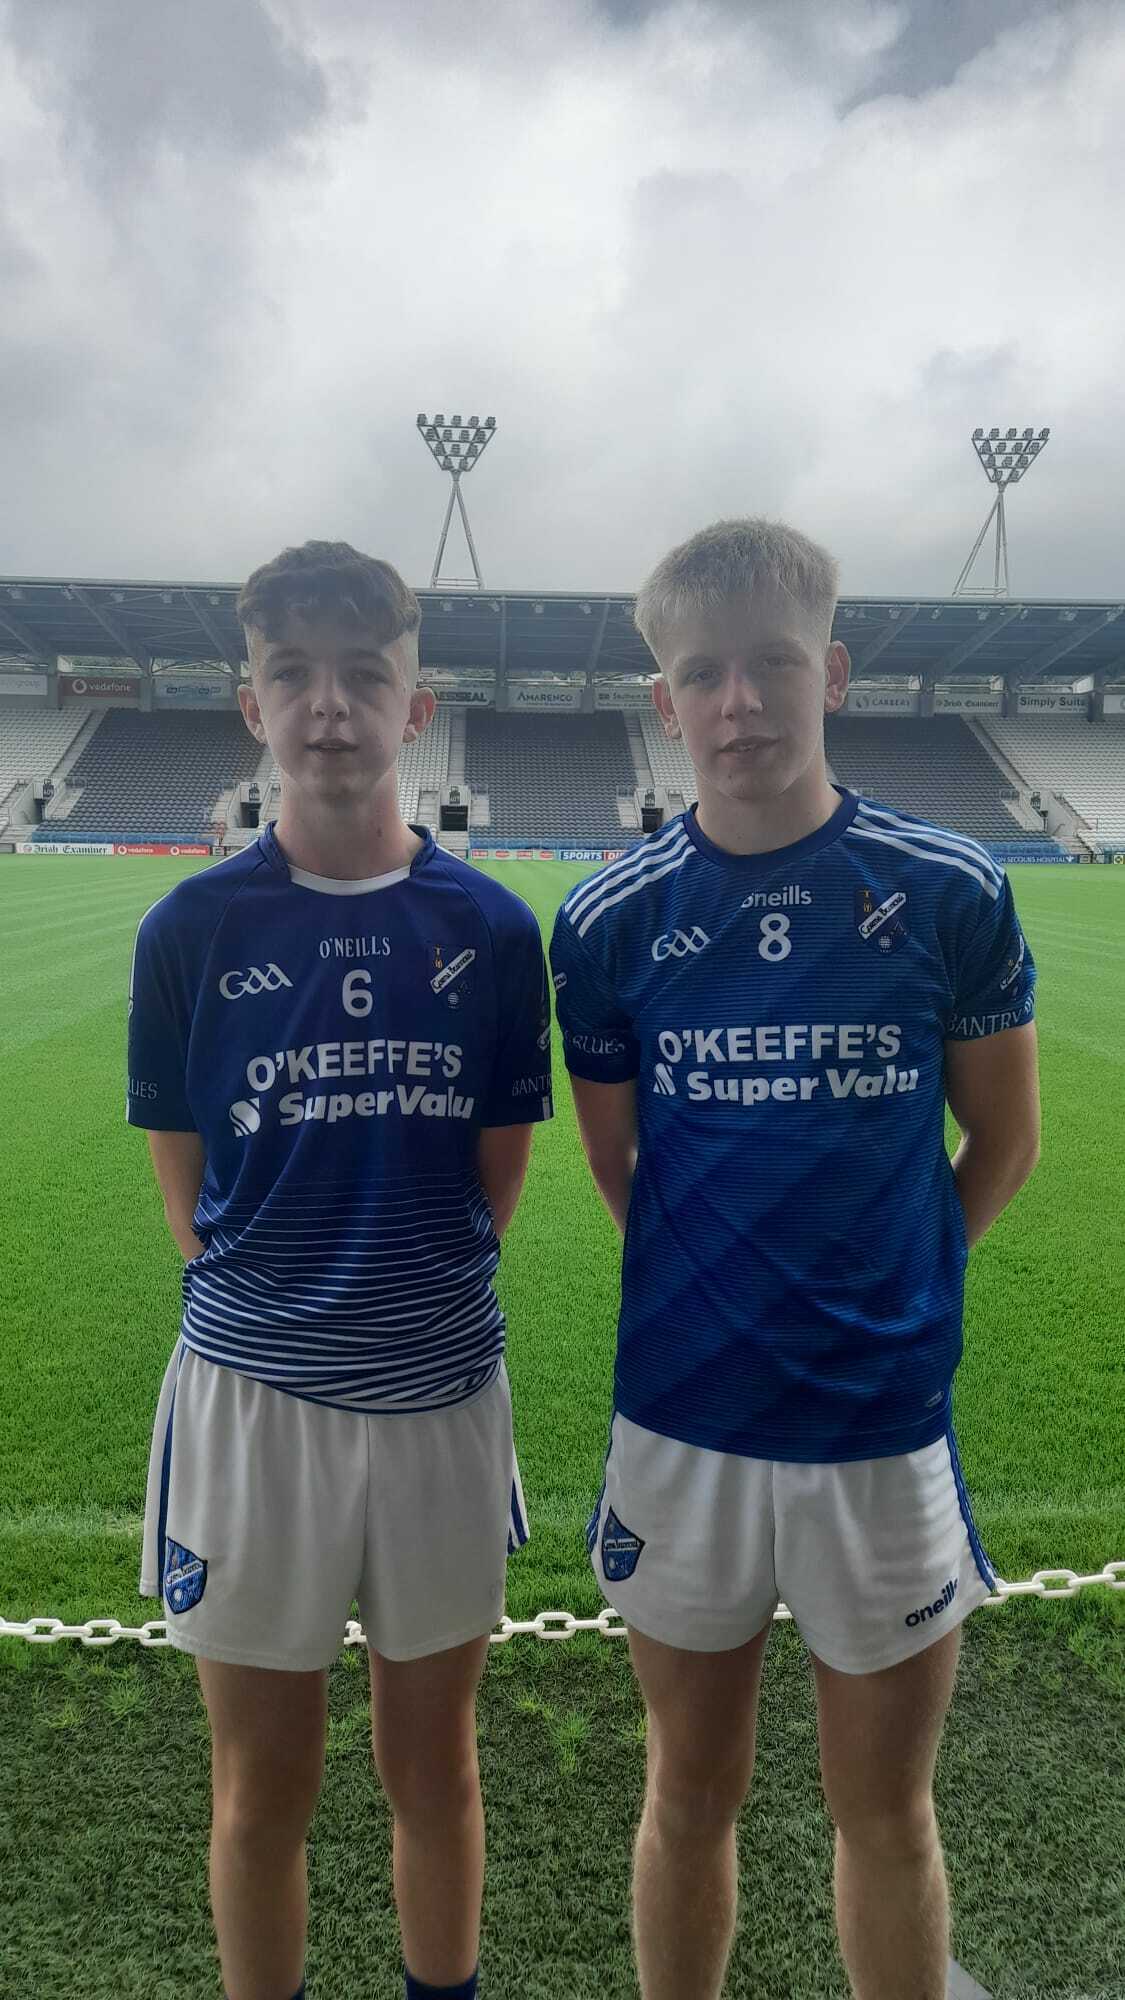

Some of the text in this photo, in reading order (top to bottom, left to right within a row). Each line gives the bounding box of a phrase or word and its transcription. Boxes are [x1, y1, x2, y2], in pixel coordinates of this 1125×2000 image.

[88, 680, 131, 692] vodafone
[1019, 696, 1056, 709] Simply
[34, 844, 108, 854] Irish Examiner
[563, 851, 602, 860] SPORTS
[319, 935, 391, 958] O'NEILLS
[758, 913, 792, 962] 8
[342, 969, 373, 1018] 6
[656, 1024, 902, 1063] O'KEEFFE'S
[246, 1039, 463, 1092] O'KEEFFE'S
